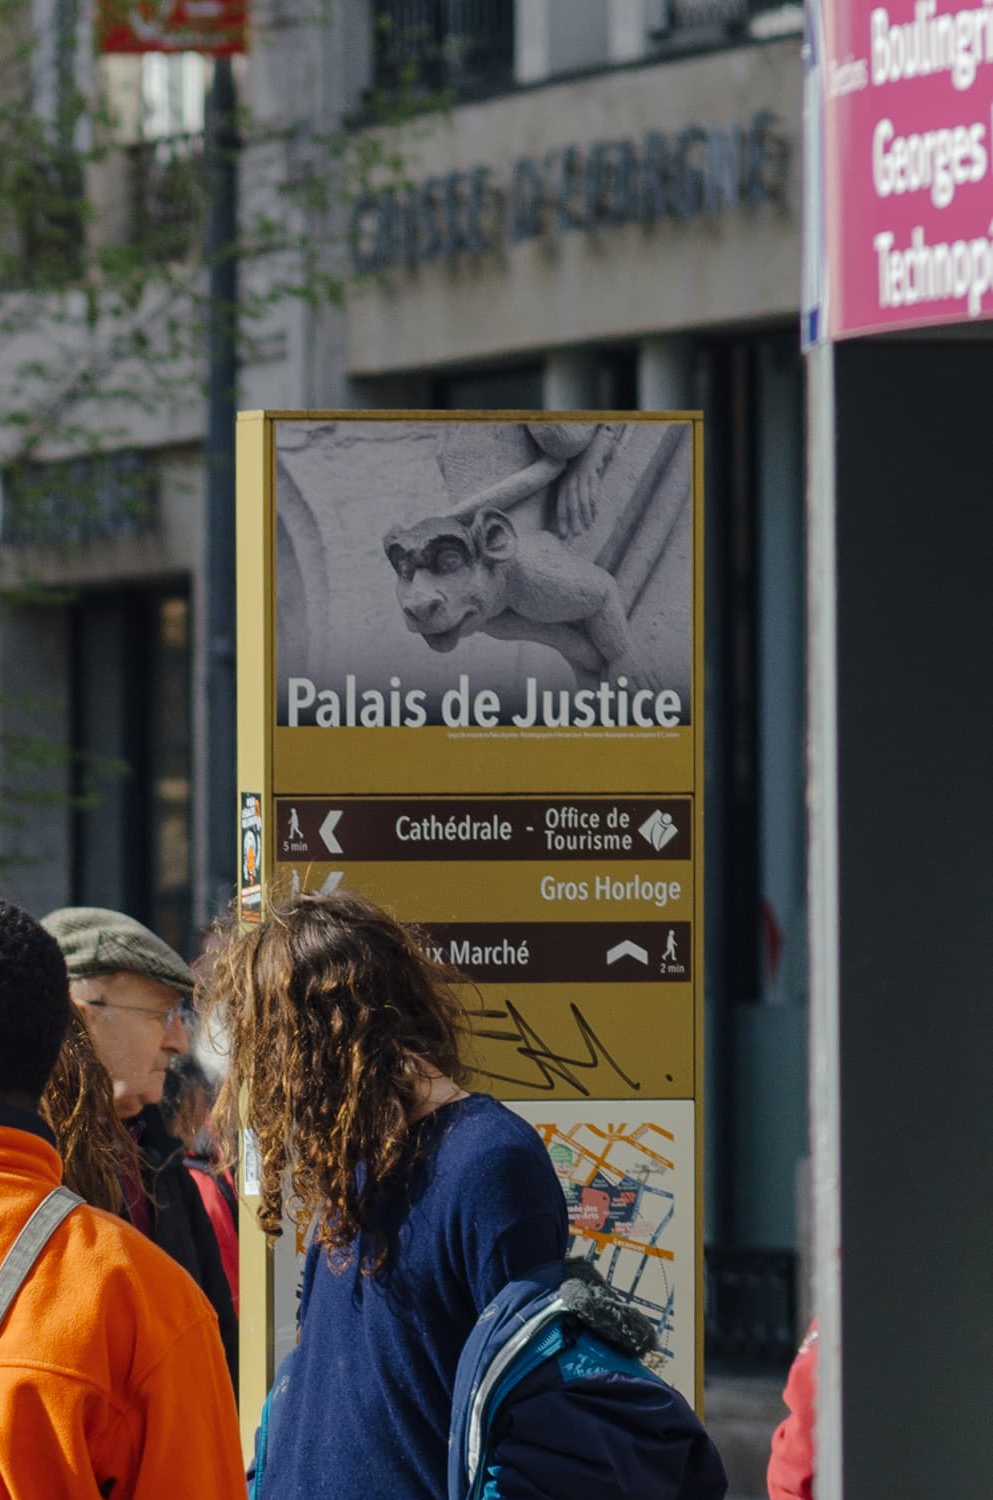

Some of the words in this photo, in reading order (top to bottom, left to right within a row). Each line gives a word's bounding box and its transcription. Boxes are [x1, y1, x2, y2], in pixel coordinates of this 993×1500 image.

[871, 118, 987, 209] Georges
[873, 217, 993, 318] Technop
[287, 674, 427, 727] Palais
[441, 674, 501, 727] de
[511, 676, 682, 727] Justice
[395, 814, 512, 841] Cathédrale
[545, 807, 600, 829] Office
[606, 807, 630, 829] de
[283, 841, 289, 852] 5
[291, 841, 308, 852] min
[544, 830, 633, 850] Tourisme
[540, 875, 589, 900] Gros
[595, 874, 681, 907] Horloge
[450, 939, 530, 965] Marché
[660, 964, 667, 974] 2
[668, 963, 685, 974] min
